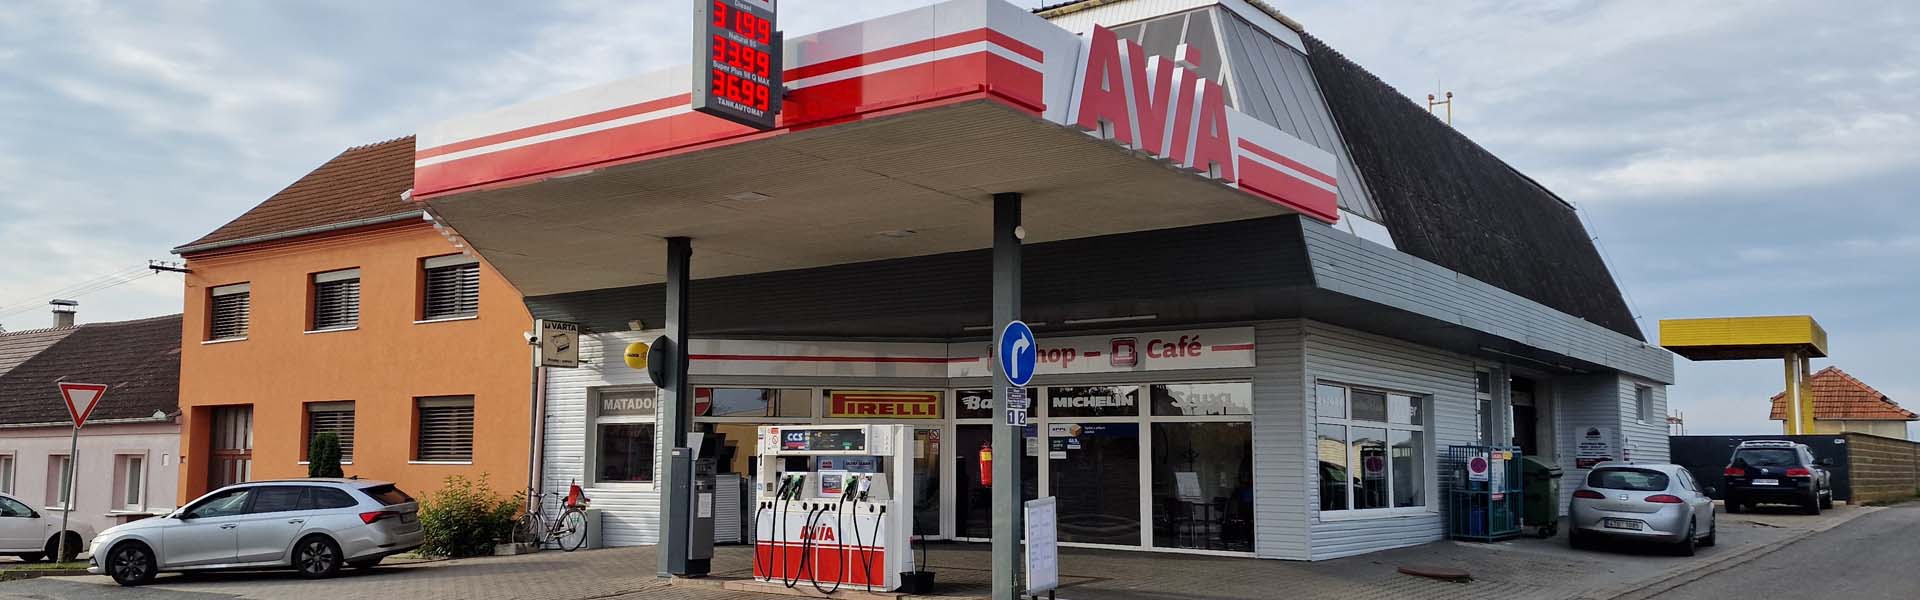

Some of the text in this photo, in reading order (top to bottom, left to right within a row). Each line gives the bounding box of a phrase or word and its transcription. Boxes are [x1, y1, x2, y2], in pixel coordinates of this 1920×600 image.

[713, 60, 730, 73] Super
[758, 75, 770, 87] MAX
[1077, 22, 1236, 184] AVIA
[551, 322, 577, 332] VARTA
[1146, 334, 1203, 359] Café
[832, 393, 937, 416] PIRELLI
[1052, 394, 1134, 409] MICHELIN
[1008, 410, 1025, 424] 1 2
[787, 432, 804, 442] CCS
[758, 453, 763, 467] 1
